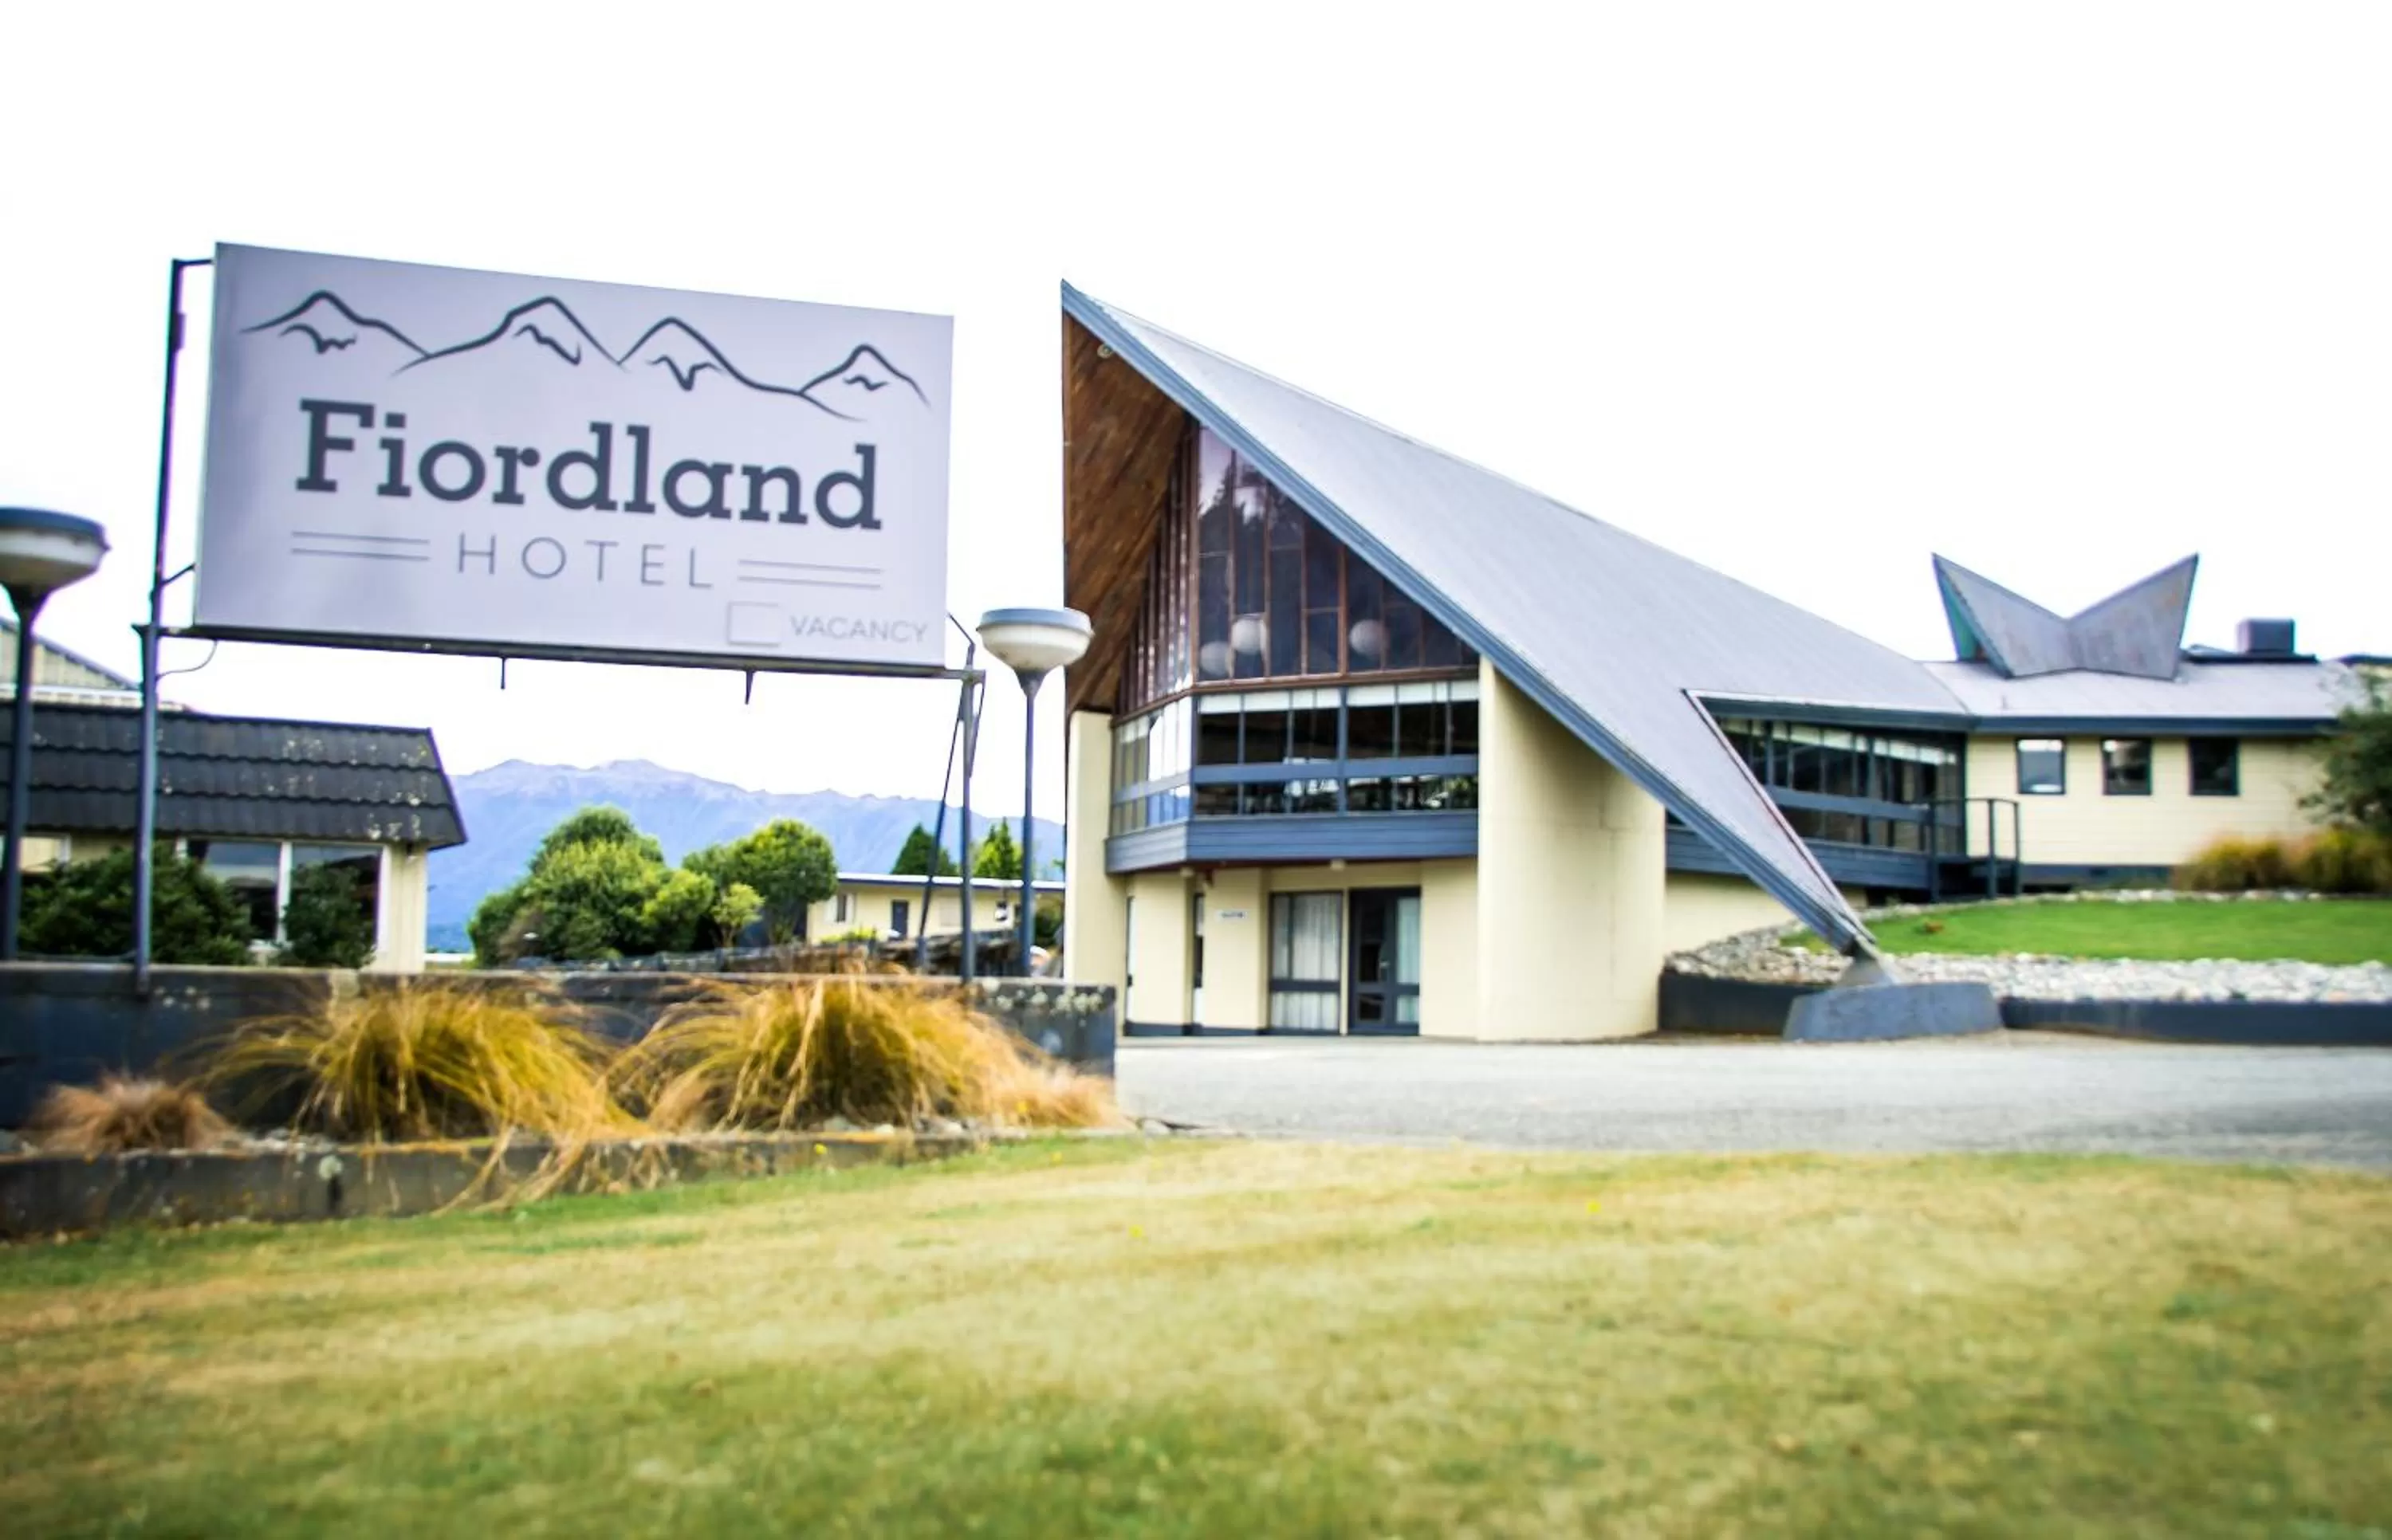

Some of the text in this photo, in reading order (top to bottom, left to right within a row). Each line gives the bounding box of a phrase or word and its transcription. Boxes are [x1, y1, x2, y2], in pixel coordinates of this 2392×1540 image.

[295, 398, 883, 530] Fiordland
[457, 532, 714, 589] HOTEL
[789, 614, 929, 643] VACANCY
